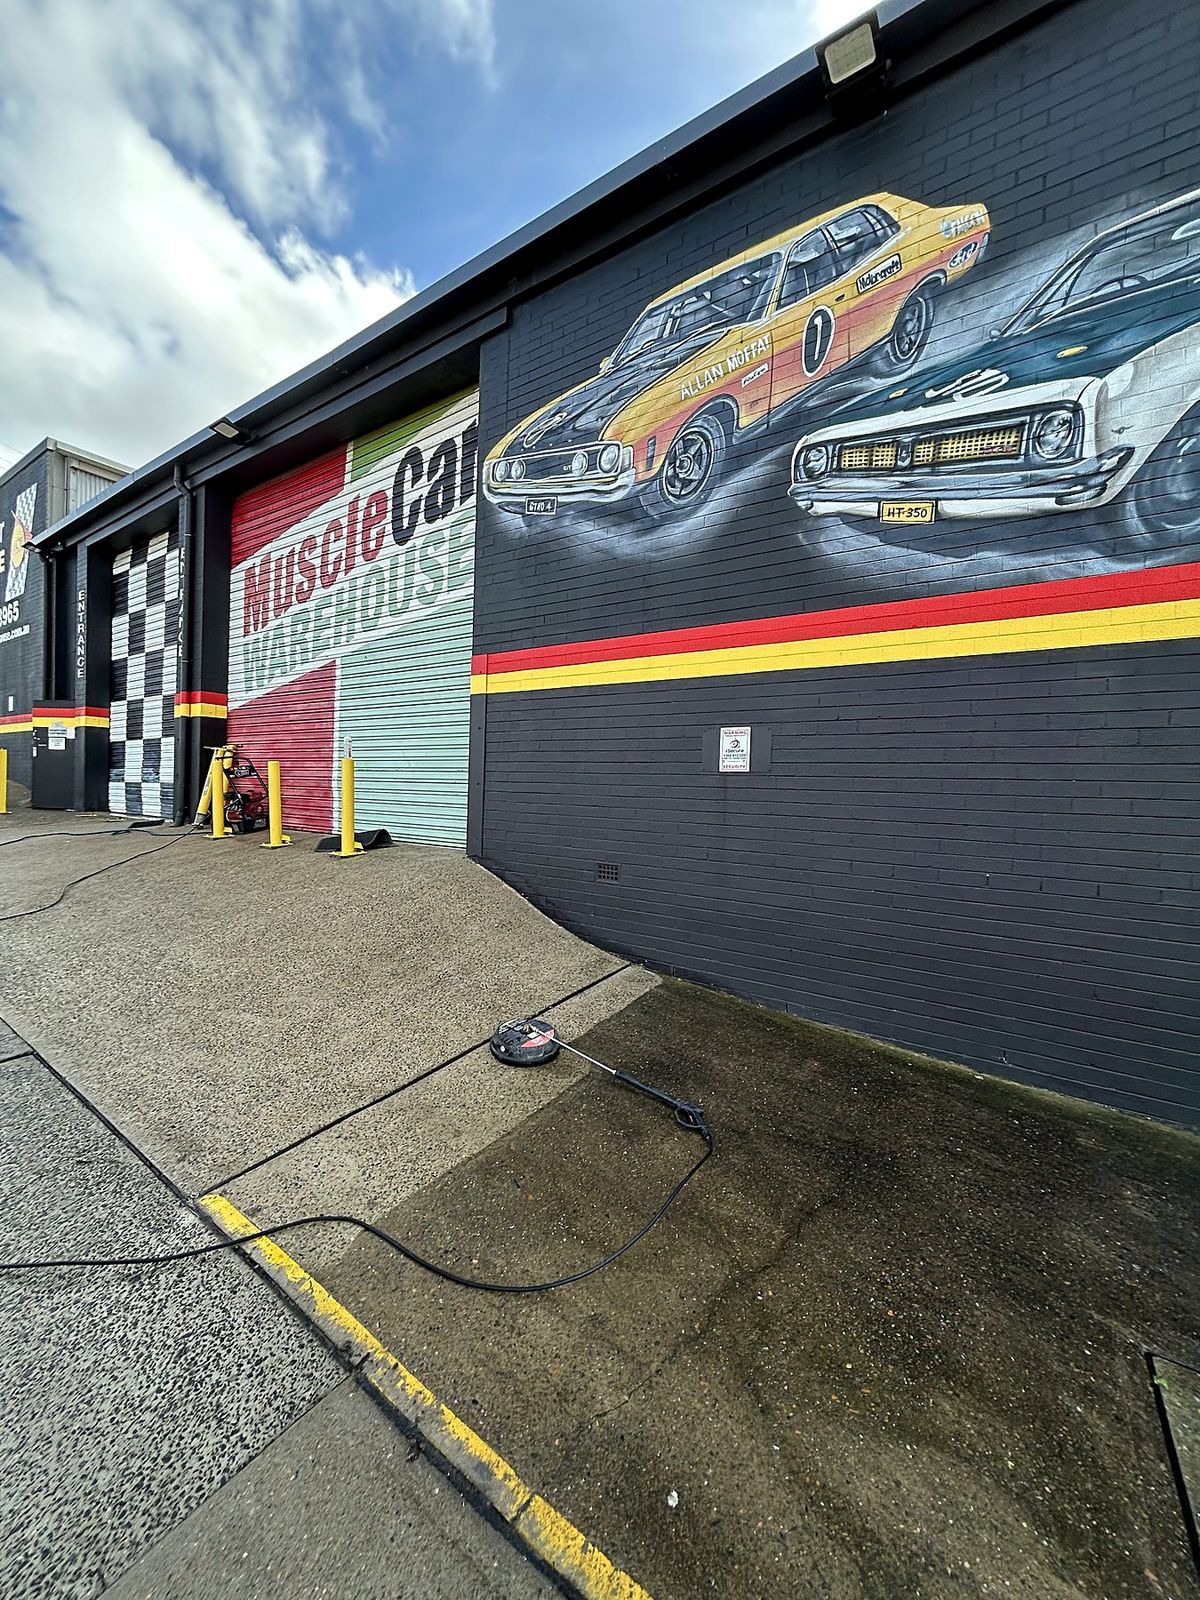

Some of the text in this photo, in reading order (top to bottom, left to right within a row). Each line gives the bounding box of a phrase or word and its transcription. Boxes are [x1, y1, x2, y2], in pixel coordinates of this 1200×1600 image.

[680, 362, 724, 401] ALLAN
[726, 333, 771, 374] MOFFAT
[813, 314, 823, 361] 1
[77, 589, 85, 679] ENTRANCE
